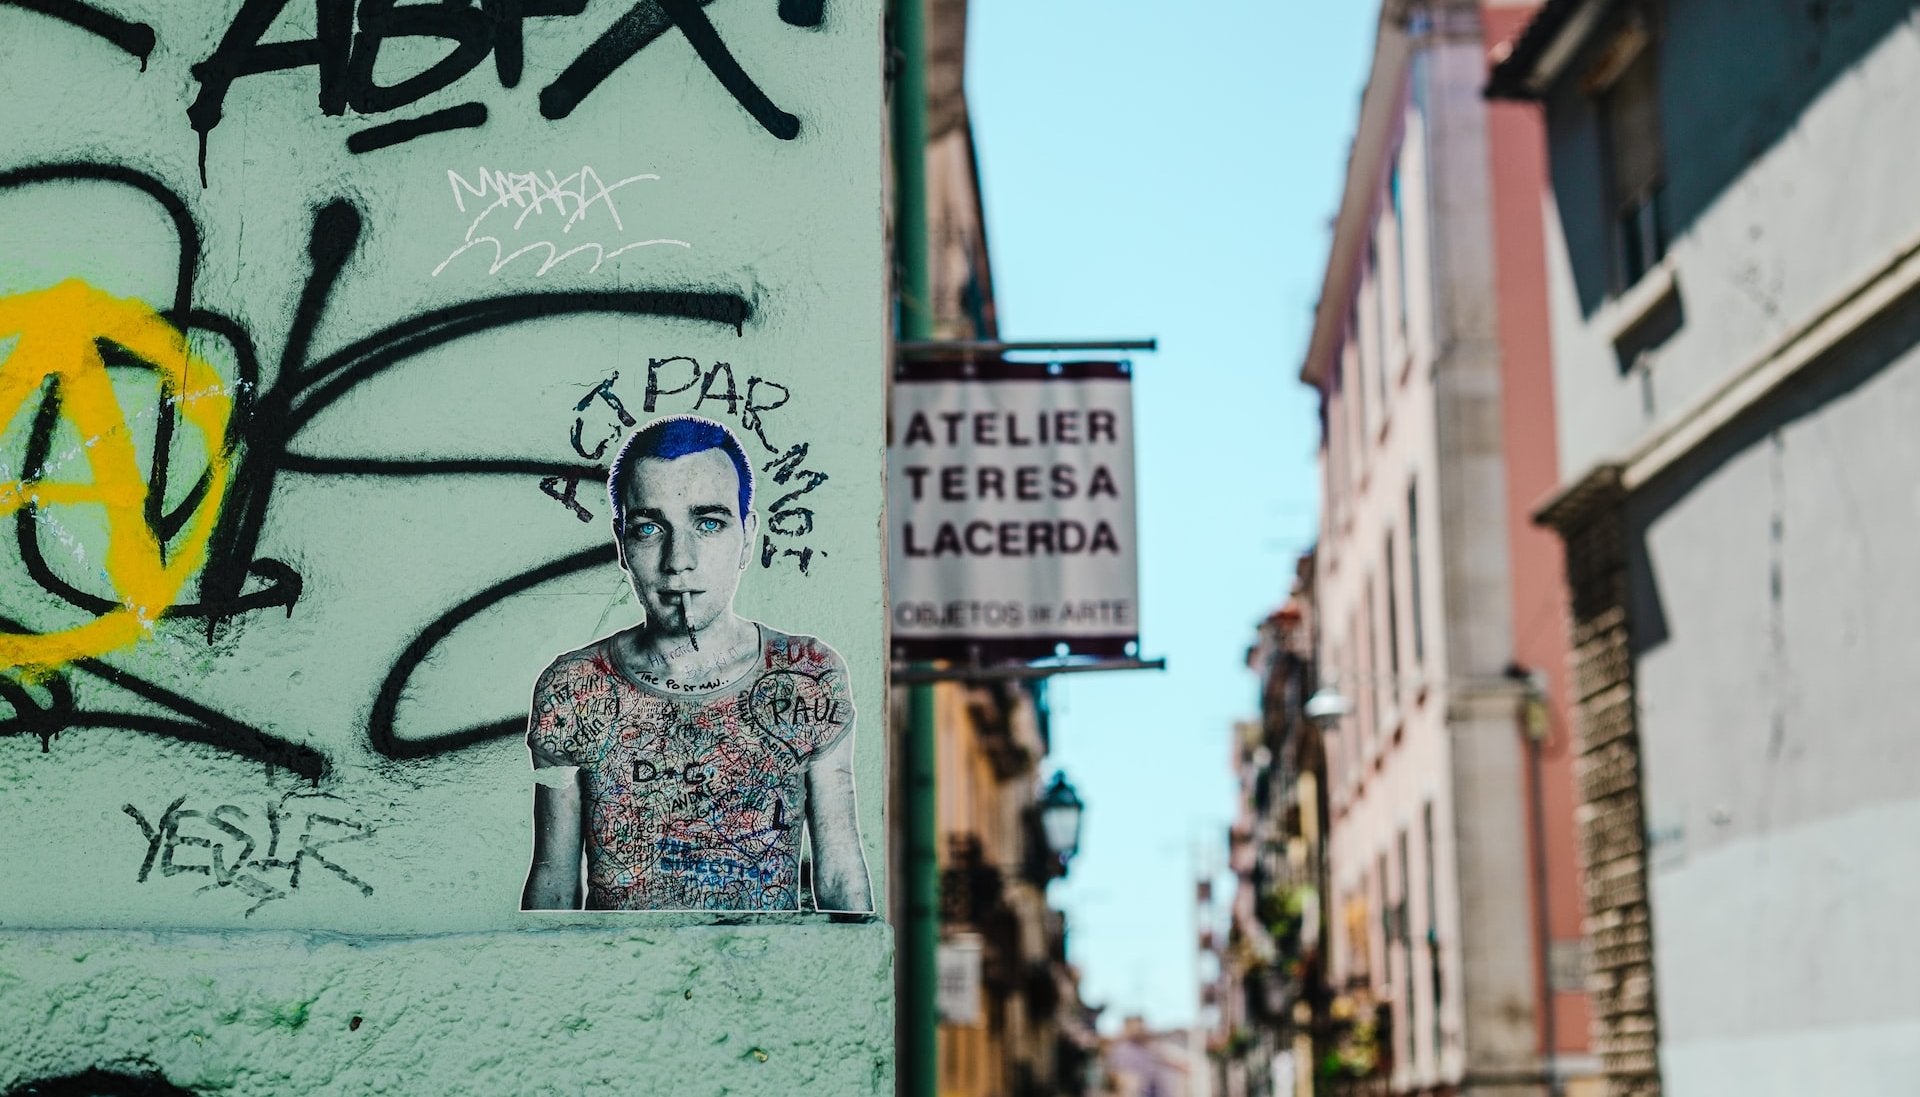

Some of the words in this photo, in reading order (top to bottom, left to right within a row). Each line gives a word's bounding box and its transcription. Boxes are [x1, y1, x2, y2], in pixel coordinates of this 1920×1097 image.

[643, 356, 790, 454] PAR
[904, 410, 1118, 446] ATELIER
[903, 465, 1119, 501] TERESA
[902, 520, 1121, 557] LACERDA
[896, 601, 1025, 628] OBJETOS
[1058, 601, 1129, 627] ARTE
